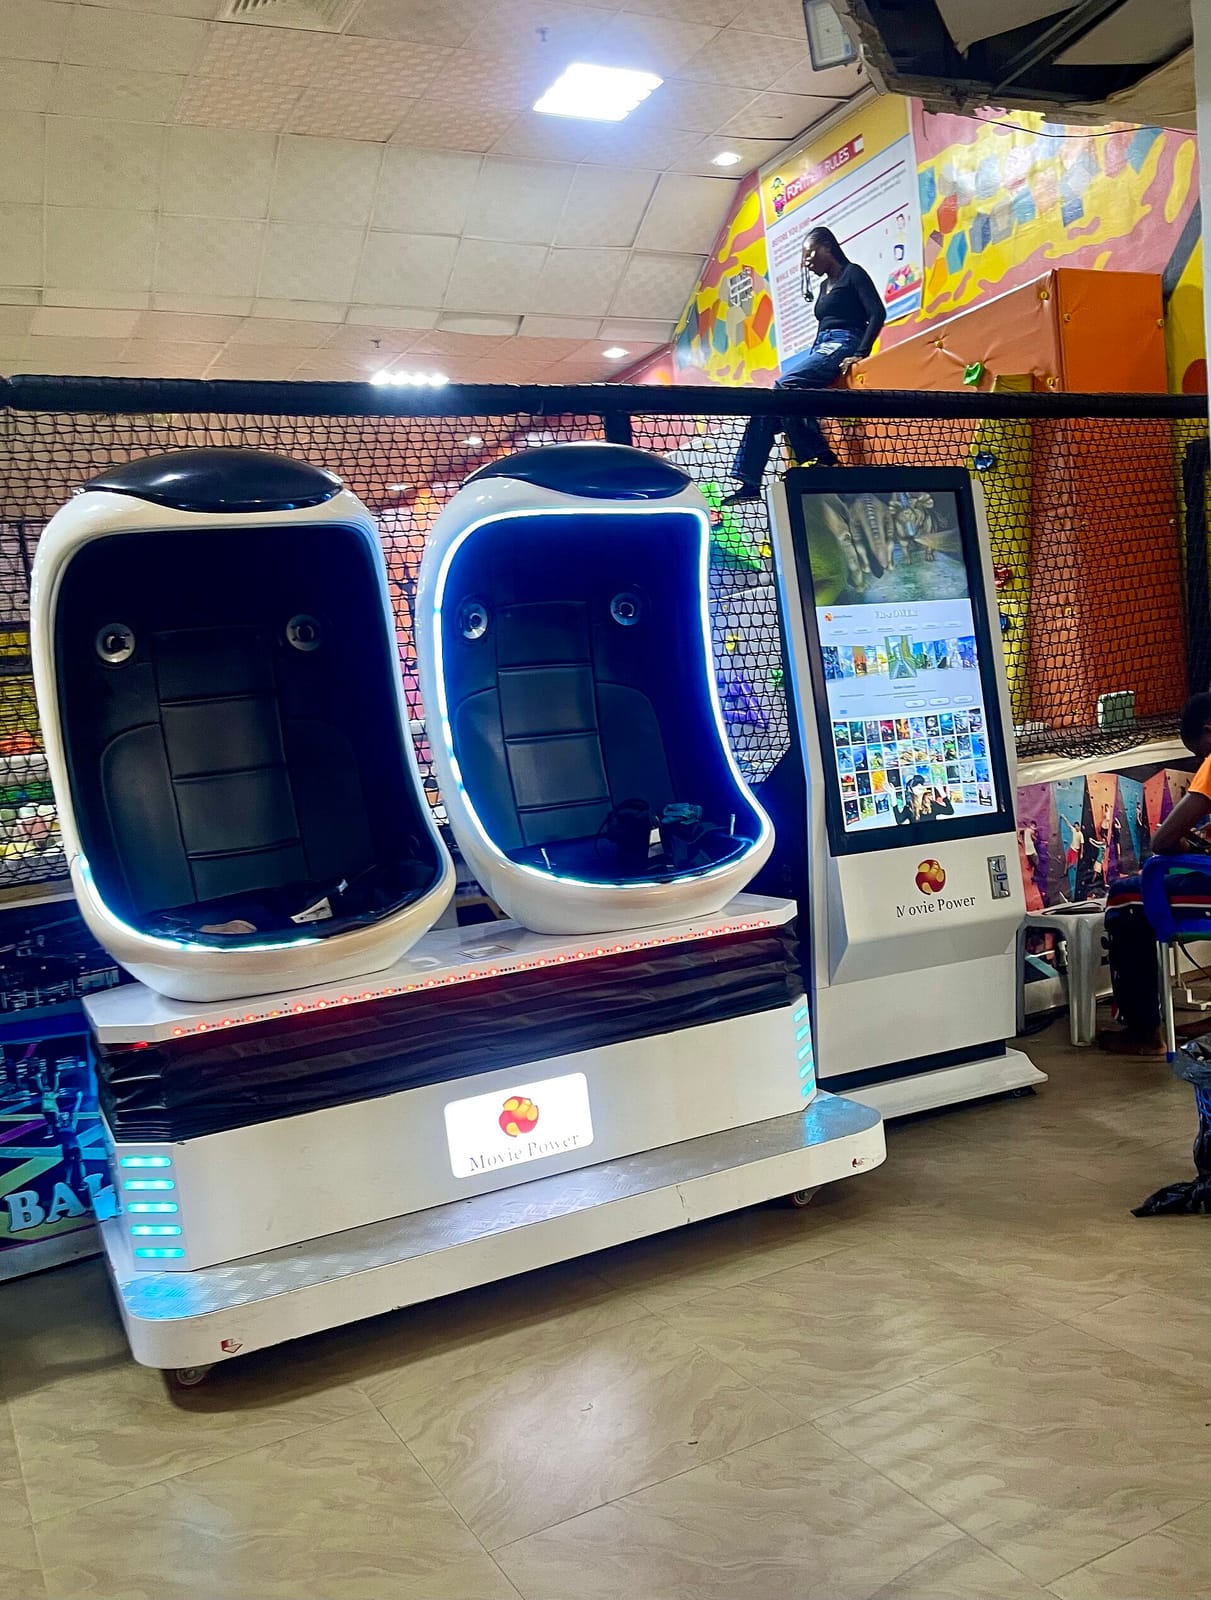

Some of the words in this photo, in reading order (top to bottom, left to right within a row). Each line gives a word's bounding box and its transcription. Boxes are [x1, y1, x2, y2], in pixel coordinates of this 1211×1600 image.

[824, 146, 850, 174] RULES
[937, 896, 976, 911] Power
[469, 1148, 522, 1172] Movie
[528, 1135, 579, 1157] Power
